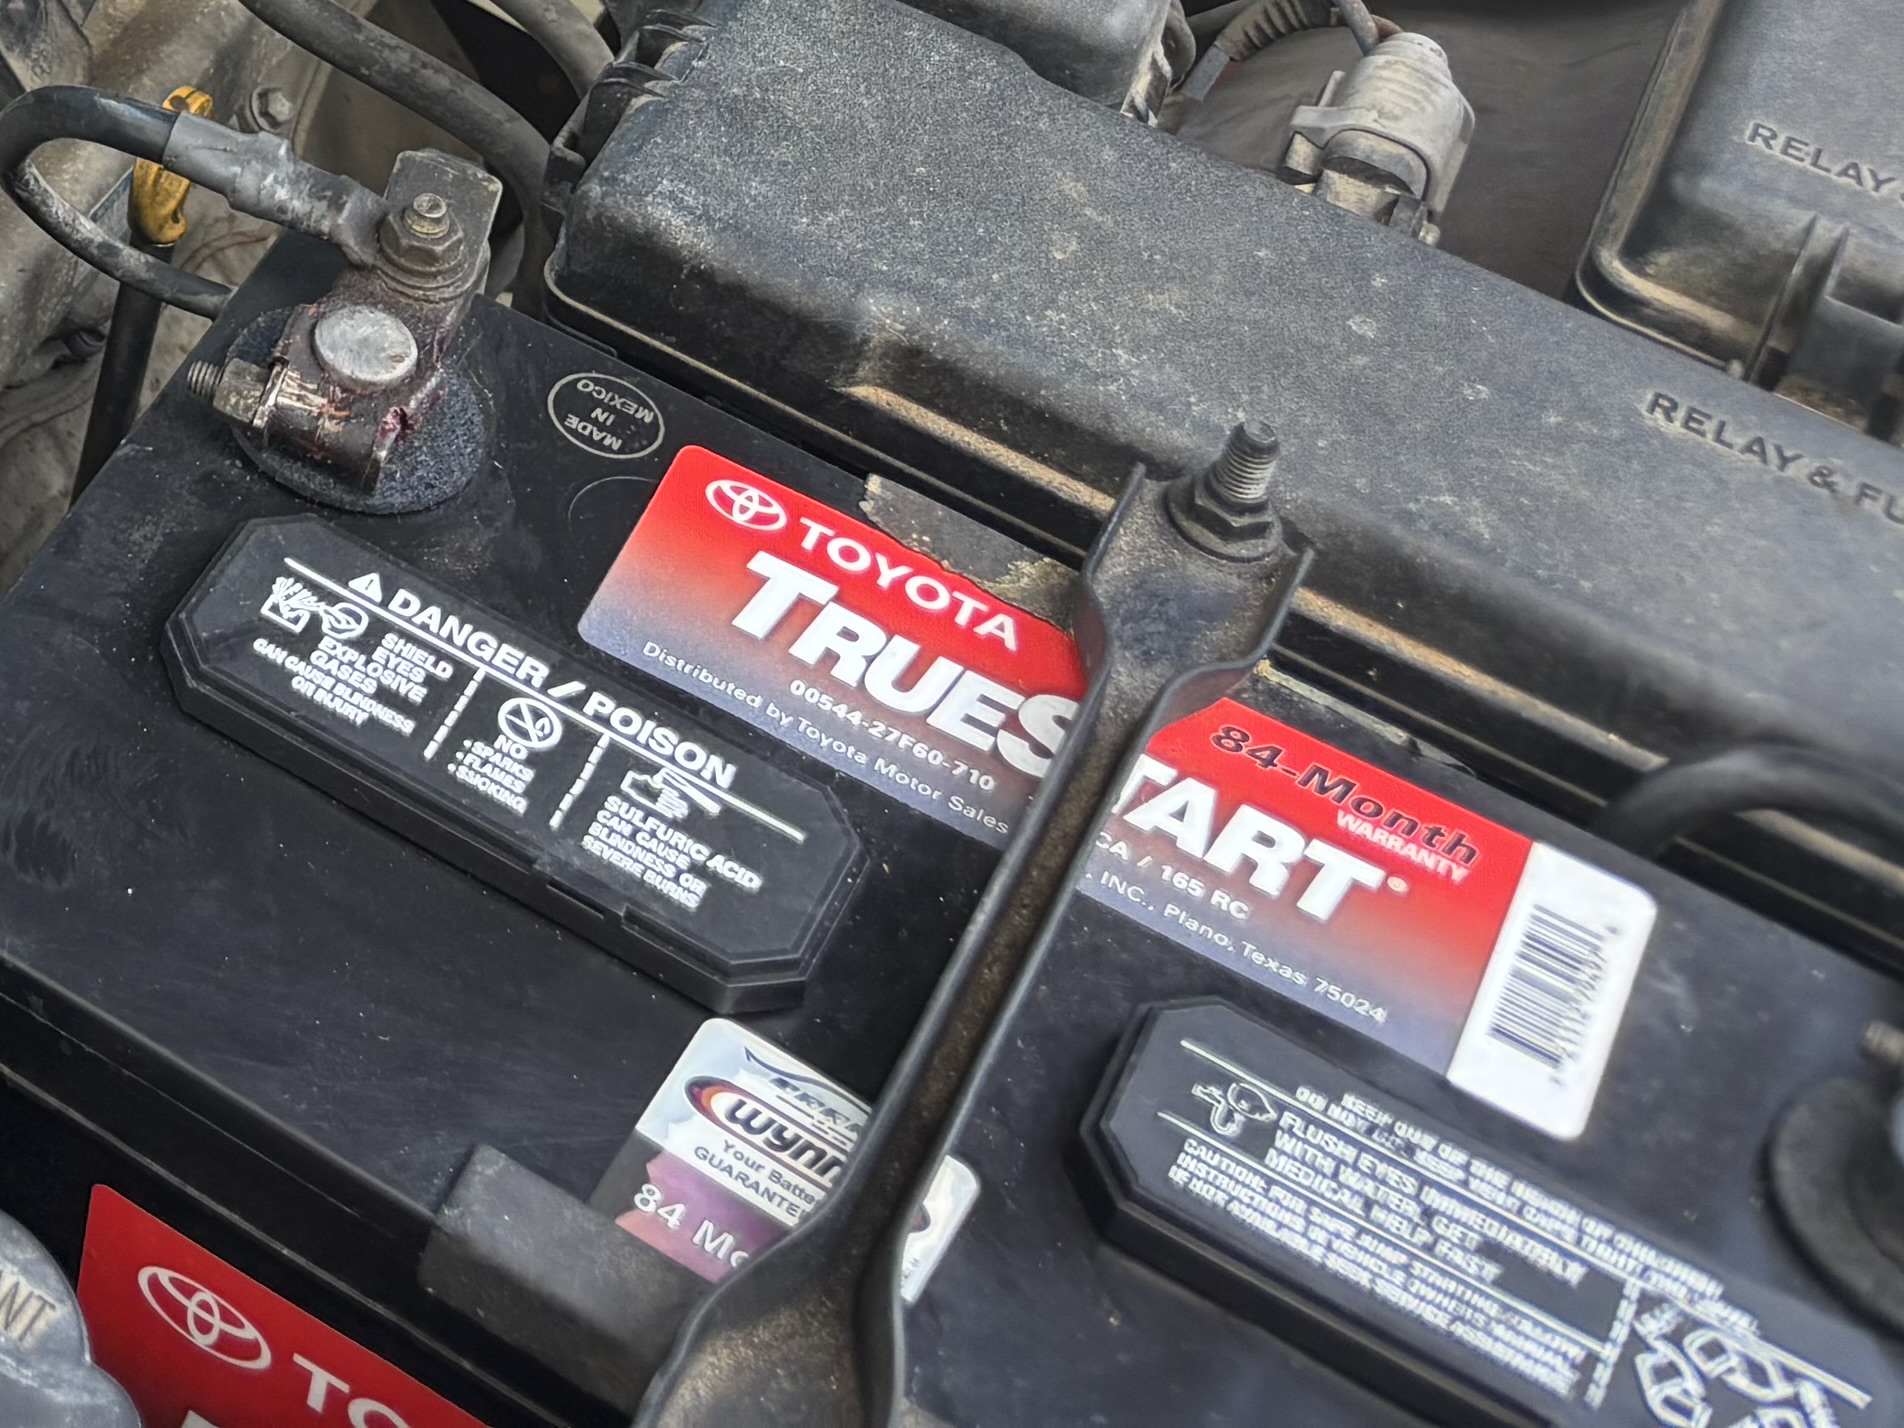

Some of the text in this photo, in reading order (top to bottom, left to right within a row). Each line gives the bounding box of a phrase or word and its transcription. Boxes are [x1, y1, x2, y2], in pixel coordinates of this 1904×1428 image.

[1746, 121, 1897, 194] RELAY
[564, 414, 623, 450] MADE
[576, 379, 654, 424] MEXICO
[590, 407, 616, 426] IN
[1646, 391, 1804, 473] RELAY
[1808, 465, 1838, 494] &
[799, 515, 1020, 652] TOYOTA
[310, 650, 379, 695] GASES
[317, 635, 429, 705] EXPLOSIVE
[371, 646, 427, 684] EYES
[381, 632, 454, 681] SHIELD
[387, 588, 551, 690] DANGER
[582, 690, 738, 790] POISON
[333, 681, 417, 737] BLINDNESS
[641, 640, 1011, 835] Distributed by Toyota Motor Sales
[789, 679, 995, 792] 00544-27F60-710
[463, 753, 526, 795] FLAMES
[470, 741, 535, 784] SPARKS
[493, 734, 529, 760] NO
[1210, 725, 1480, 866] 84-Month
[587, 821, 678, 878] BLINDNESS
[596, 809, 693, 870] CAN CAUSE
[603, 794, 764, 893] SULFURIC ACID
[1335, 808, 1472, 885] WARRANTY
[1161, 864, 1206, 898] 165
[1210, 887, 1251, 921] RC
[1163, 900, 1236, 952] Plano,
[1241, 941, 1309, 986] Texas
[1313, 977, 1389, 1025] 75024
[693, 1145, 806, 1222] GUARANTE
[722, 1138, 818, 1207] Your Batte
[1264, 1147, 1367, 1218] MEDICAL
[1279, 1110, 1359, 1165] FLUSH
[1357, 1150, 1420, 1196] EYES
[633, 1183, 687, 1229] 84
[1274, 1129, 1337, 1177] WITH
[1431, 1215, 1484, 1252] GET
